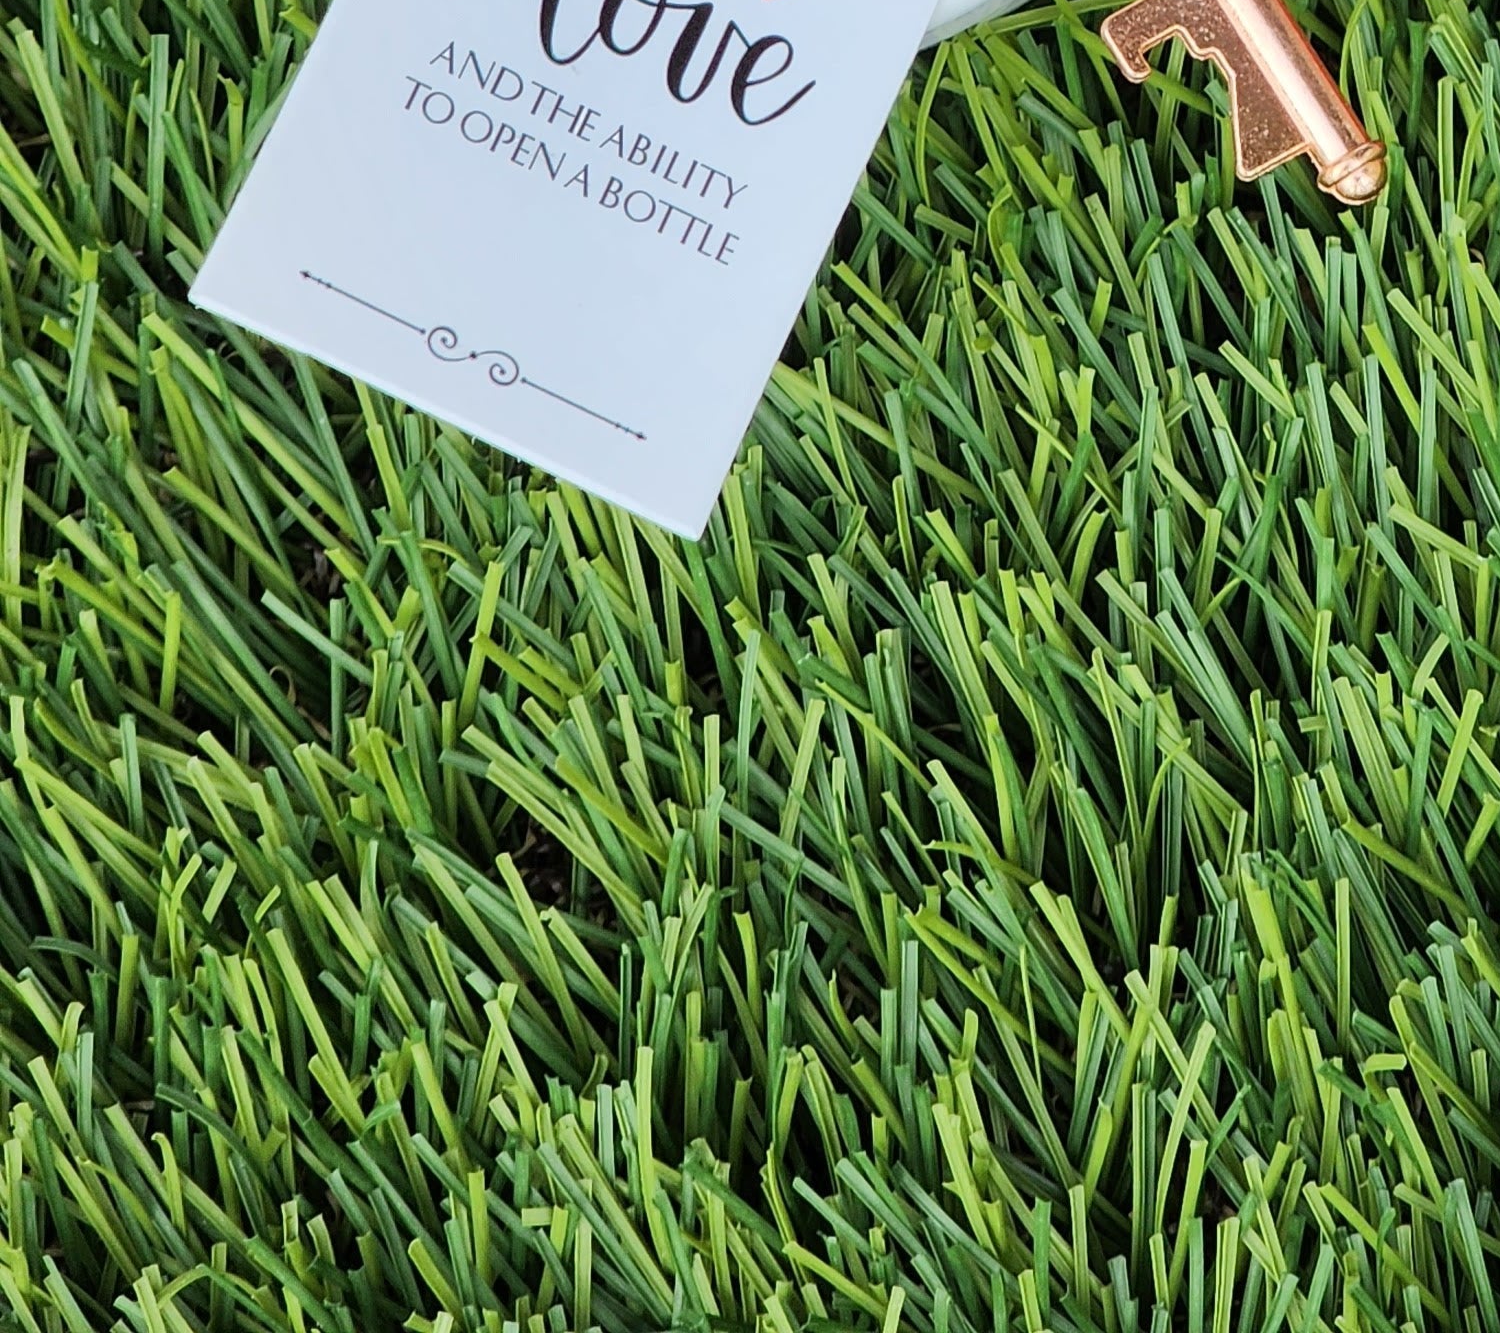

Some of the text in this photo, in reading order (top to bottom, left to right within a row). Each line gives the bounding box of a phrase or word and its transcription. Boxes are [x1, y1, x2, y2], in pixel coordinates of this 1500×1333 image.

[405, 77, 739, 265] TO OPEN A BOTTLE
[430, 41, 748, 210] AND THE ABILITY
